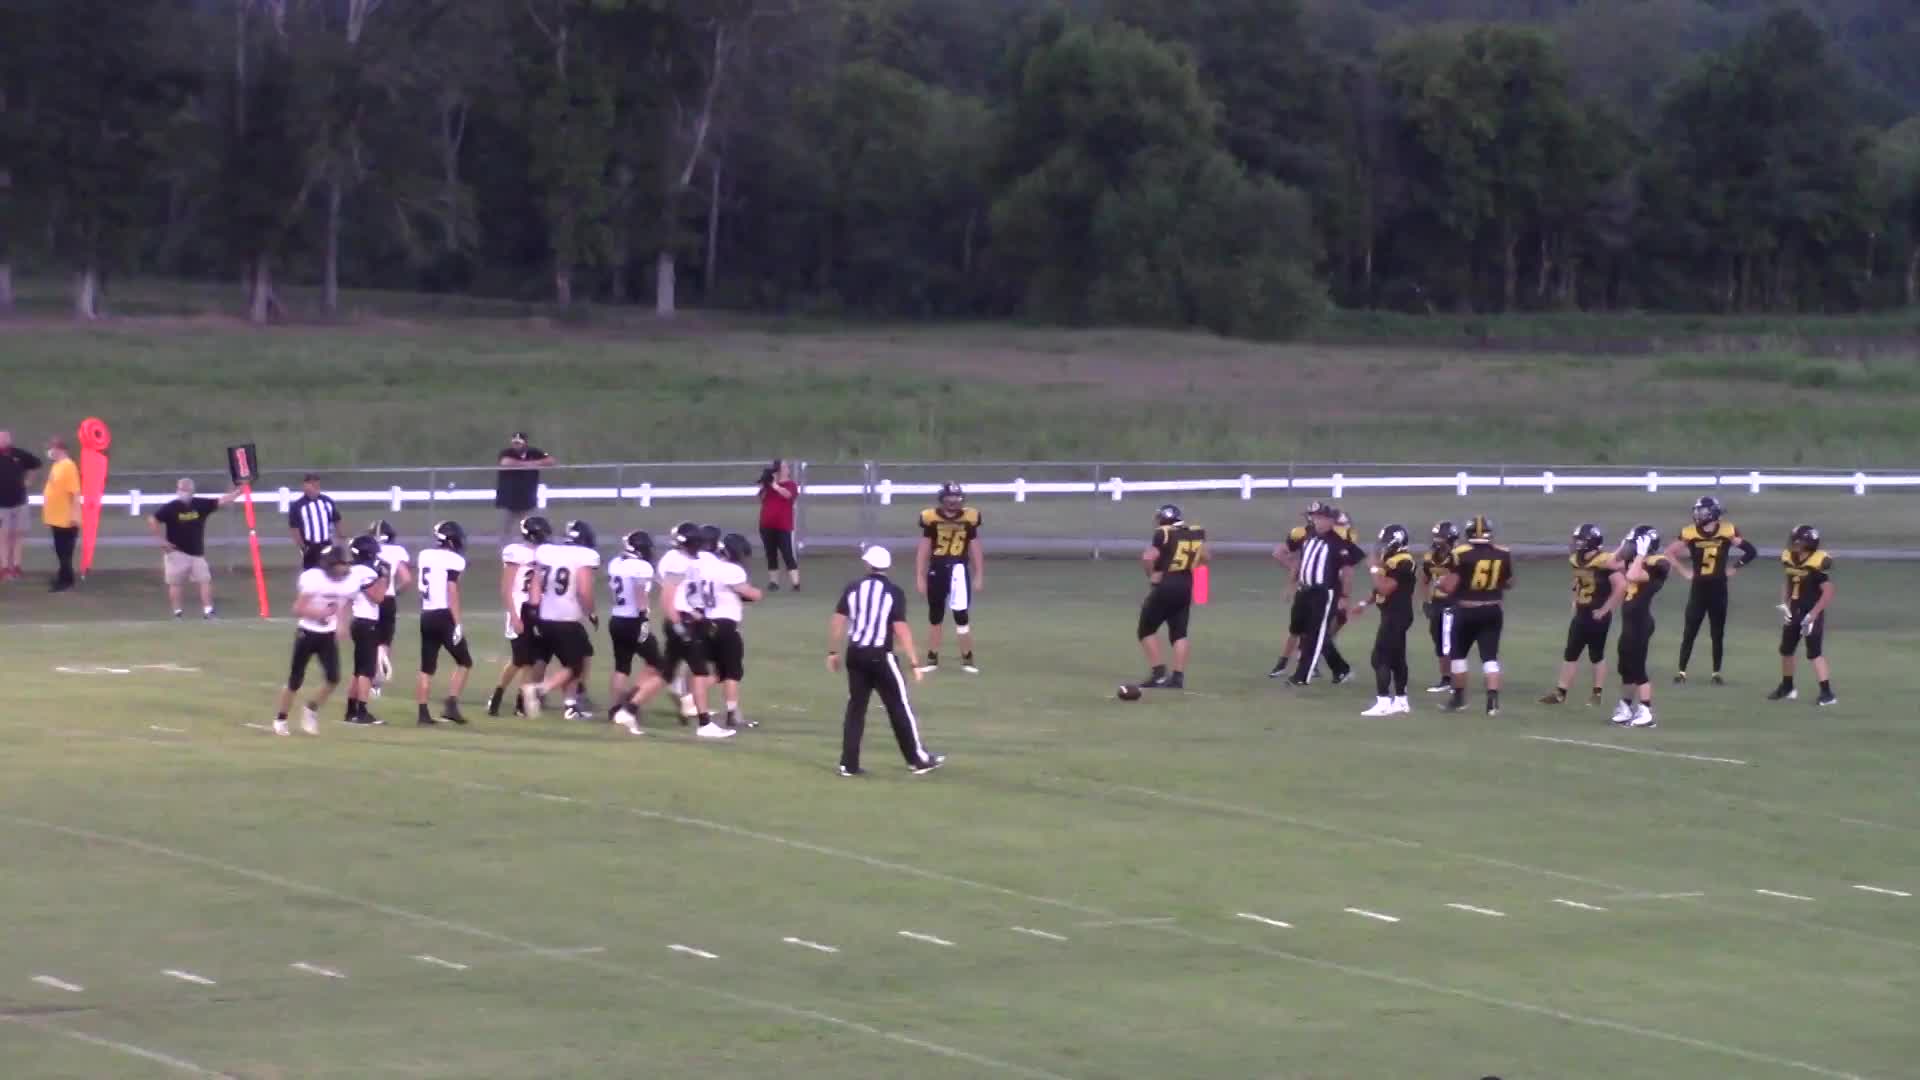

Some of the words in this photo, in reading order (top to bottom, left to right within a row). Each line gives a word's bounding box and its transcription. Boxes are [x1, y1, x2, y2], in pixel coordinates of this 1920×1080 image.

[933, 530, 967, 556] 56
[1168, 540, 1203, 571] 57
[1472, 559, 1502, 591] 61
[1701, 547, 1718, 575] 5
[420, 566, 431, 600] 5
[539, 564, 571, 596] 79
